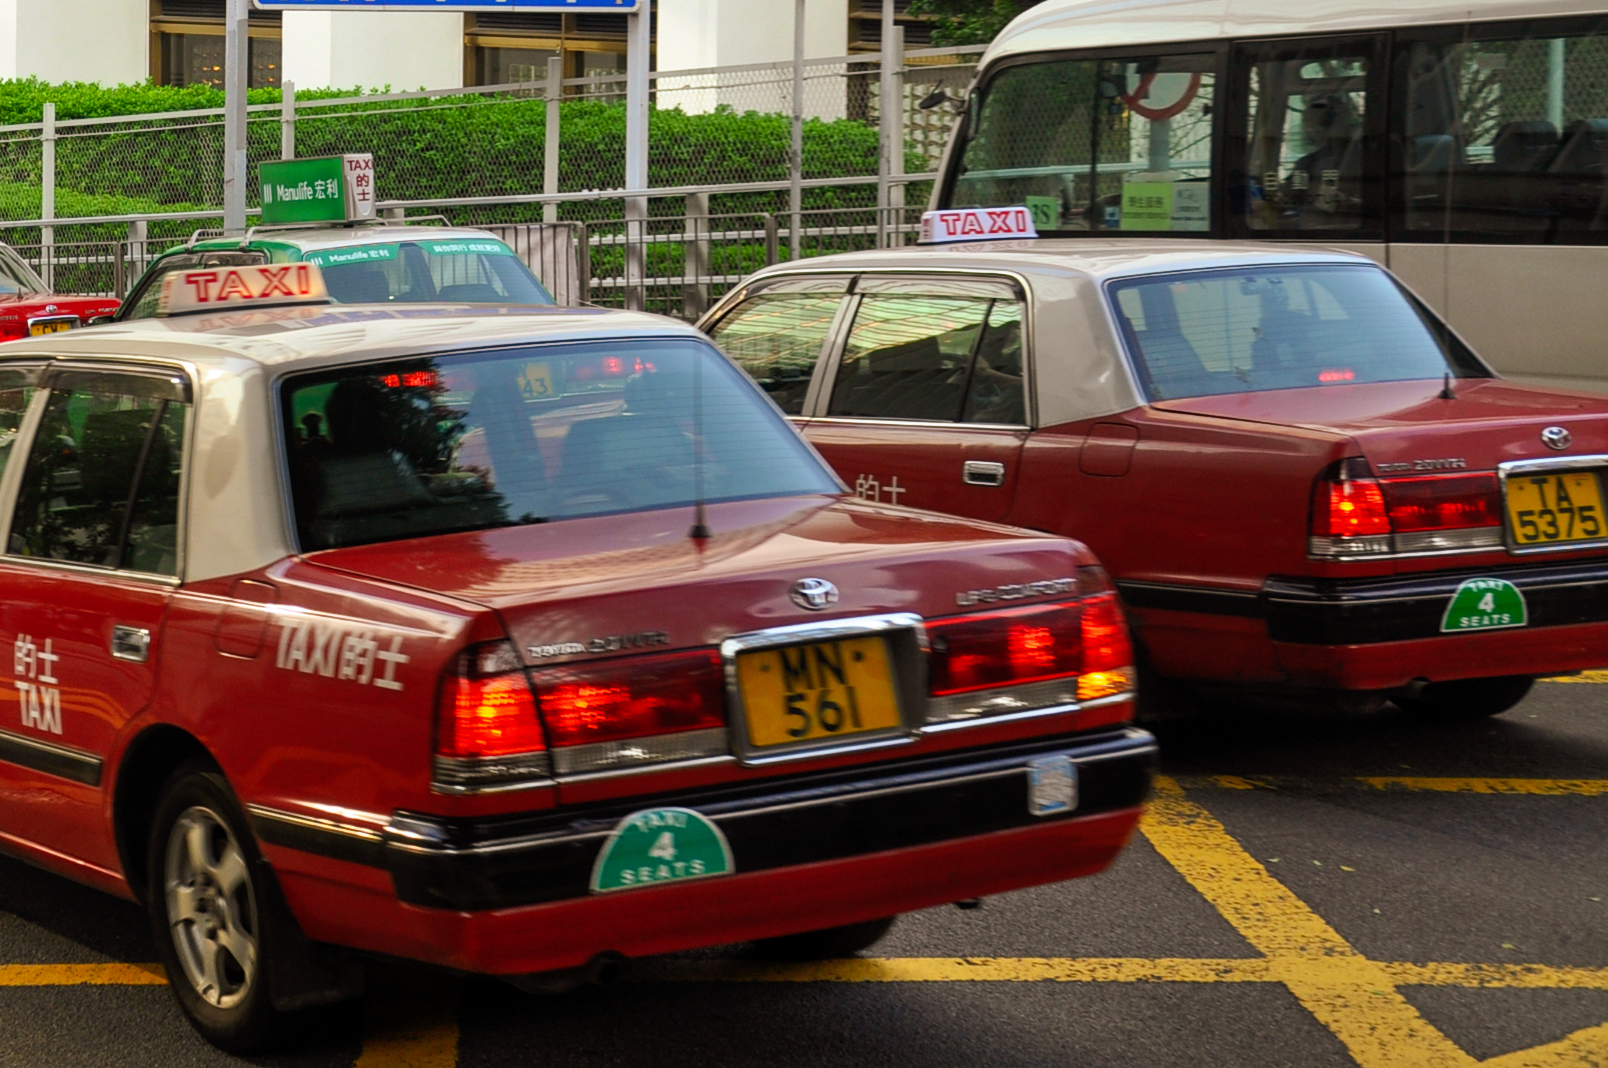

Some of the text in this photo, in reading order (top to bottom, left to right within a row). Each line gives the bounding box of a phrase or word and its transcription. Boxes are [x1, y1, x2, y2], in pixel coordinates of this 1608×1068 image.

[347, 159, 372, 172] TAX
[277, 178, 339, 201] Manulife 宏利
[356, 173, 370, 202] 的士
[940, 210, 1027, 236] TAXI
[330, 250, 369, 263] Manulife
[185, 265, 310, 302] TAXI
[1530, 476, 1574, 510] TA
[1517, 505, 1601, 541] 5375
[1478, 592, 1495, 613] 4
[1459, 613, 1511, 627] SEATS
[14, 633, 60, 684] 的士
[780, 641, 849, 694] MN
[14, 680, 63, 735] TAXI
[783, 685, 863, 738] 561
[648, 832, 678, 861] 4
[620, 859, 706, 885] SEATS
